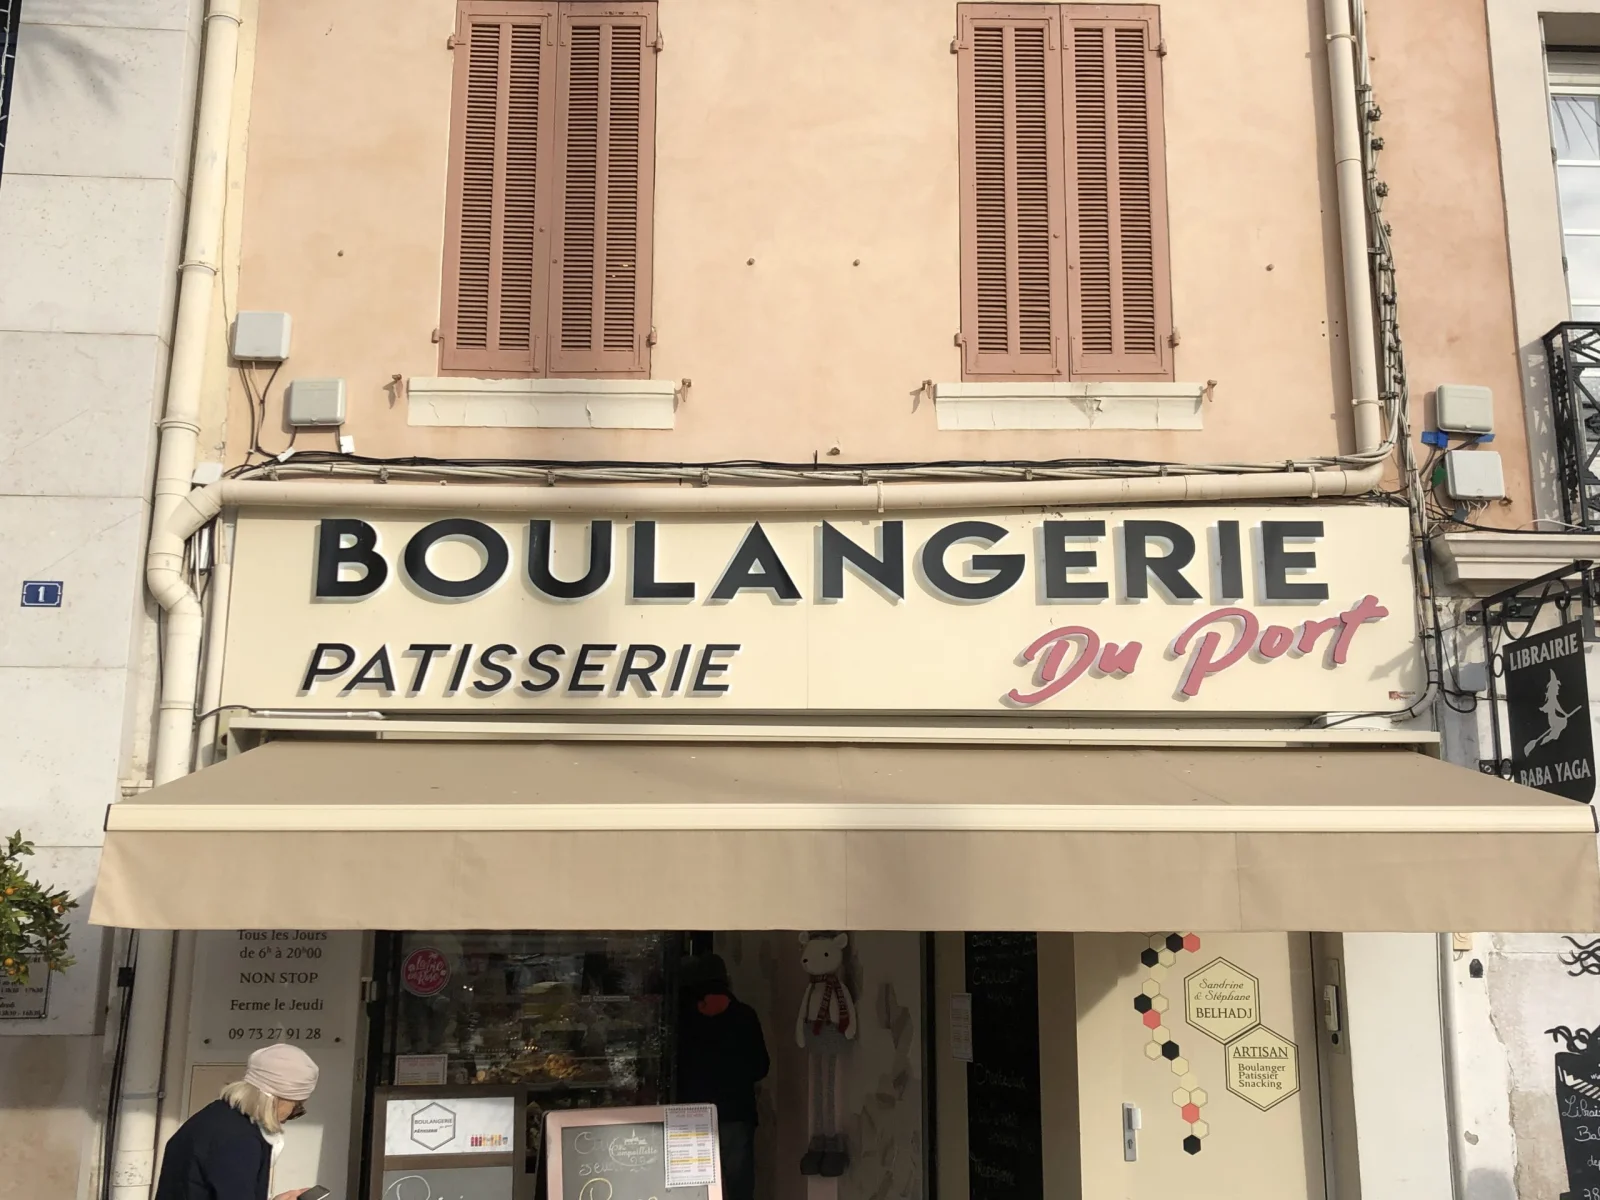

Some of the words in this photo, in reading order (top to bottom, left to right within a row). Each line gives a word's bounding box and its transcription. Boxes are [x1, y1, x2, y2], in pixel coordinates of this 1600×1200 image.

[315, 517, 1330, 603] BOULANGERIE
[37, 585, 46, 603] 1
[1007, 625, 1143, 704] Du
[1172, 594, 1390, 698] Port
[1509, 633, 1579, 672] LIBRAIRIE
[300, 642, 742, 693] PATISSERIE
[1520, 765, 1552, 788] BABA
[1555, 758, 1592, 784] YAGA
[236, 929, 268, 941] Tous
[271, 929, 290, 941] les
[292, 929, 328, 941] Jours
[239, 946, 255, 959] de
[274, 946, 283, 959] à
[239, 972, 276, 984] NON
[279, 972, 319, 984] STOP
[1198, 978, 1245, 990] Sandrine
[1193, 992, 1203, 1001] &
[1204, 989, 1251, 1004] Stéphane
[230, 999, 271, 1011] Ferme
[274, 998, 286, 1011] le
[288, 998, 324, 1011] Jeudi
[1195, 1006, 1253, 1020] BELHADJ
[228, 1028, 245, 1040] 09
[248, 1028, 264, 1040] 73
[267, 1028, 283, 1040] 27
[286, 1028, 301, 1040] 91
[305, 1028, 322, 1040] 28
[1232, 1046, 1289, 1059] ARTISAN
[1237, 1062, 1286, 1074] Boulanger
[1238, 1071, 1279, 1080] Patissier
[1238, 1079, 1282, 1091] Snacking
[1562, 1095, 1600, 1118] Librai
